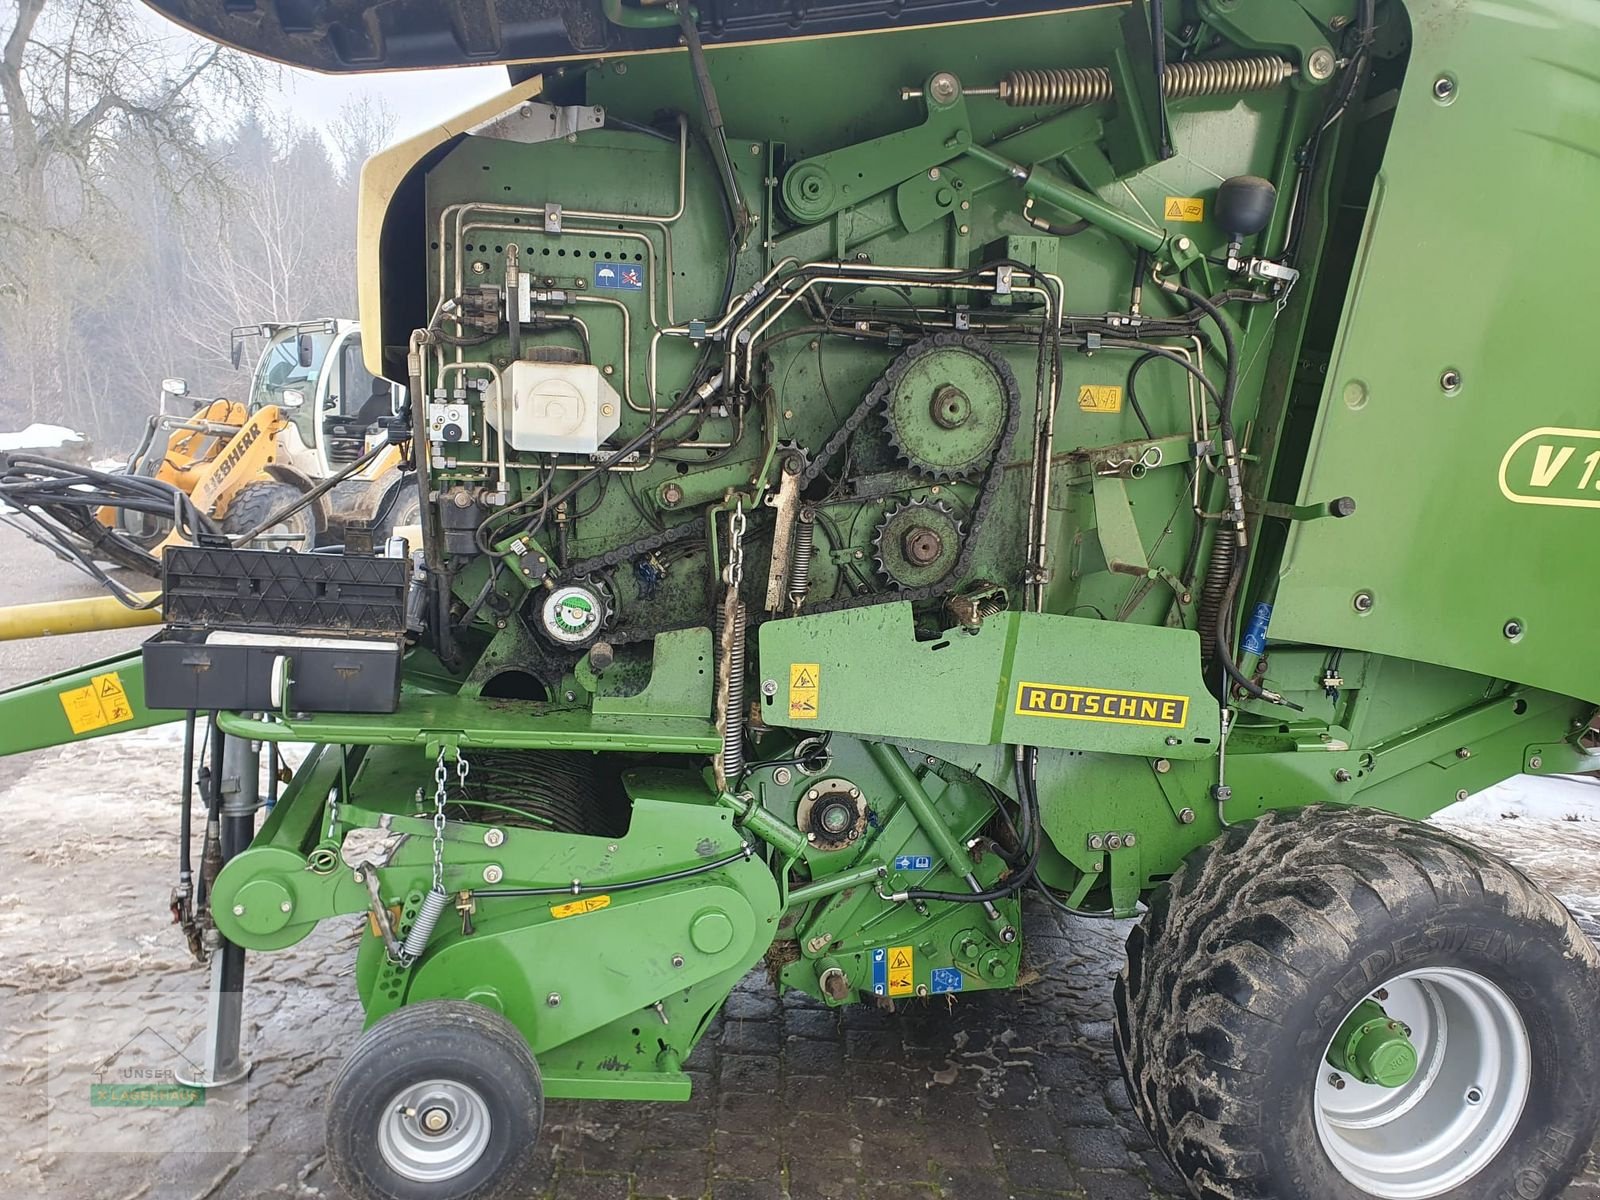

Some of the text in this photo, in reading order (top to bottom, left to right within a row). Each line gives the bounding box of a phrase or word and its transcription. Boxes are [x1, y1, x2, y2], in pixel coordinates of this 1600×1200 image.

[204, 423, 261, 496] LIEBHERR
[1530, 444, 1600, 492] V 1
[1029, 690, 1176, 720] ROTSCHNE
